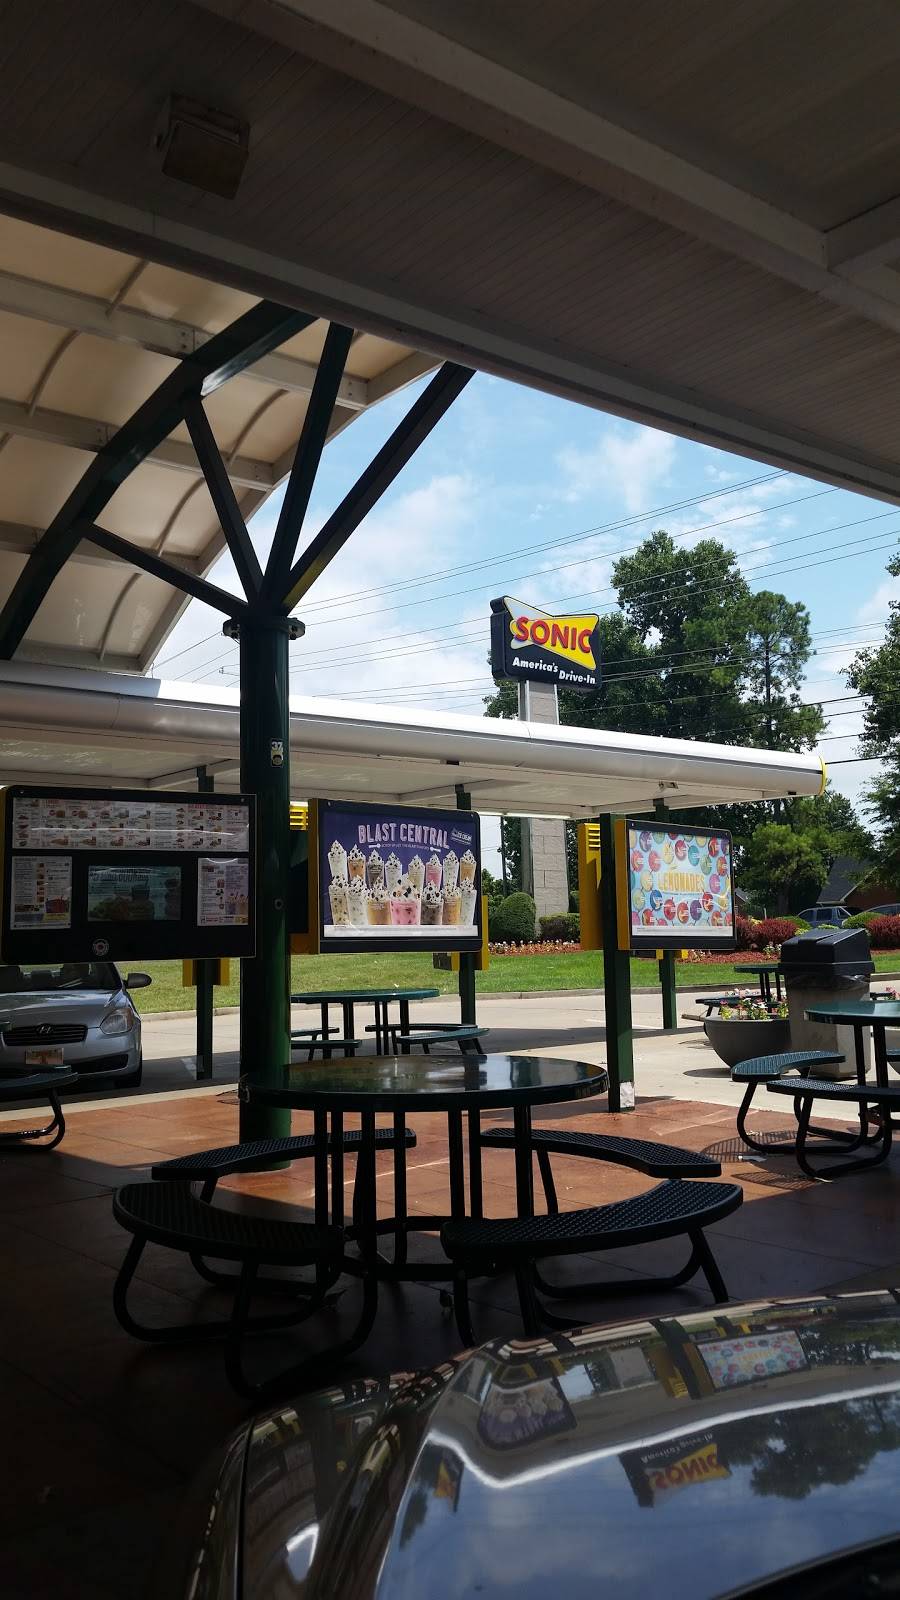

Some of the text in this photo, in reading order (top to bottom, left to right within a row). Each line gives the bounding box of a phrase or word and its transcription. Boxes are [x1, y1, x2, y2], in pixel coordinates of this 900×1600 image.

[514, 616, 593, 653] SONIC
[512, 657, 596, 685] America's Drive-In
[358, 823, 397, 844] BLAST
[400, 823, 450, 849] CENTRAL
[658, 872, 705, 892] LEMONADES
